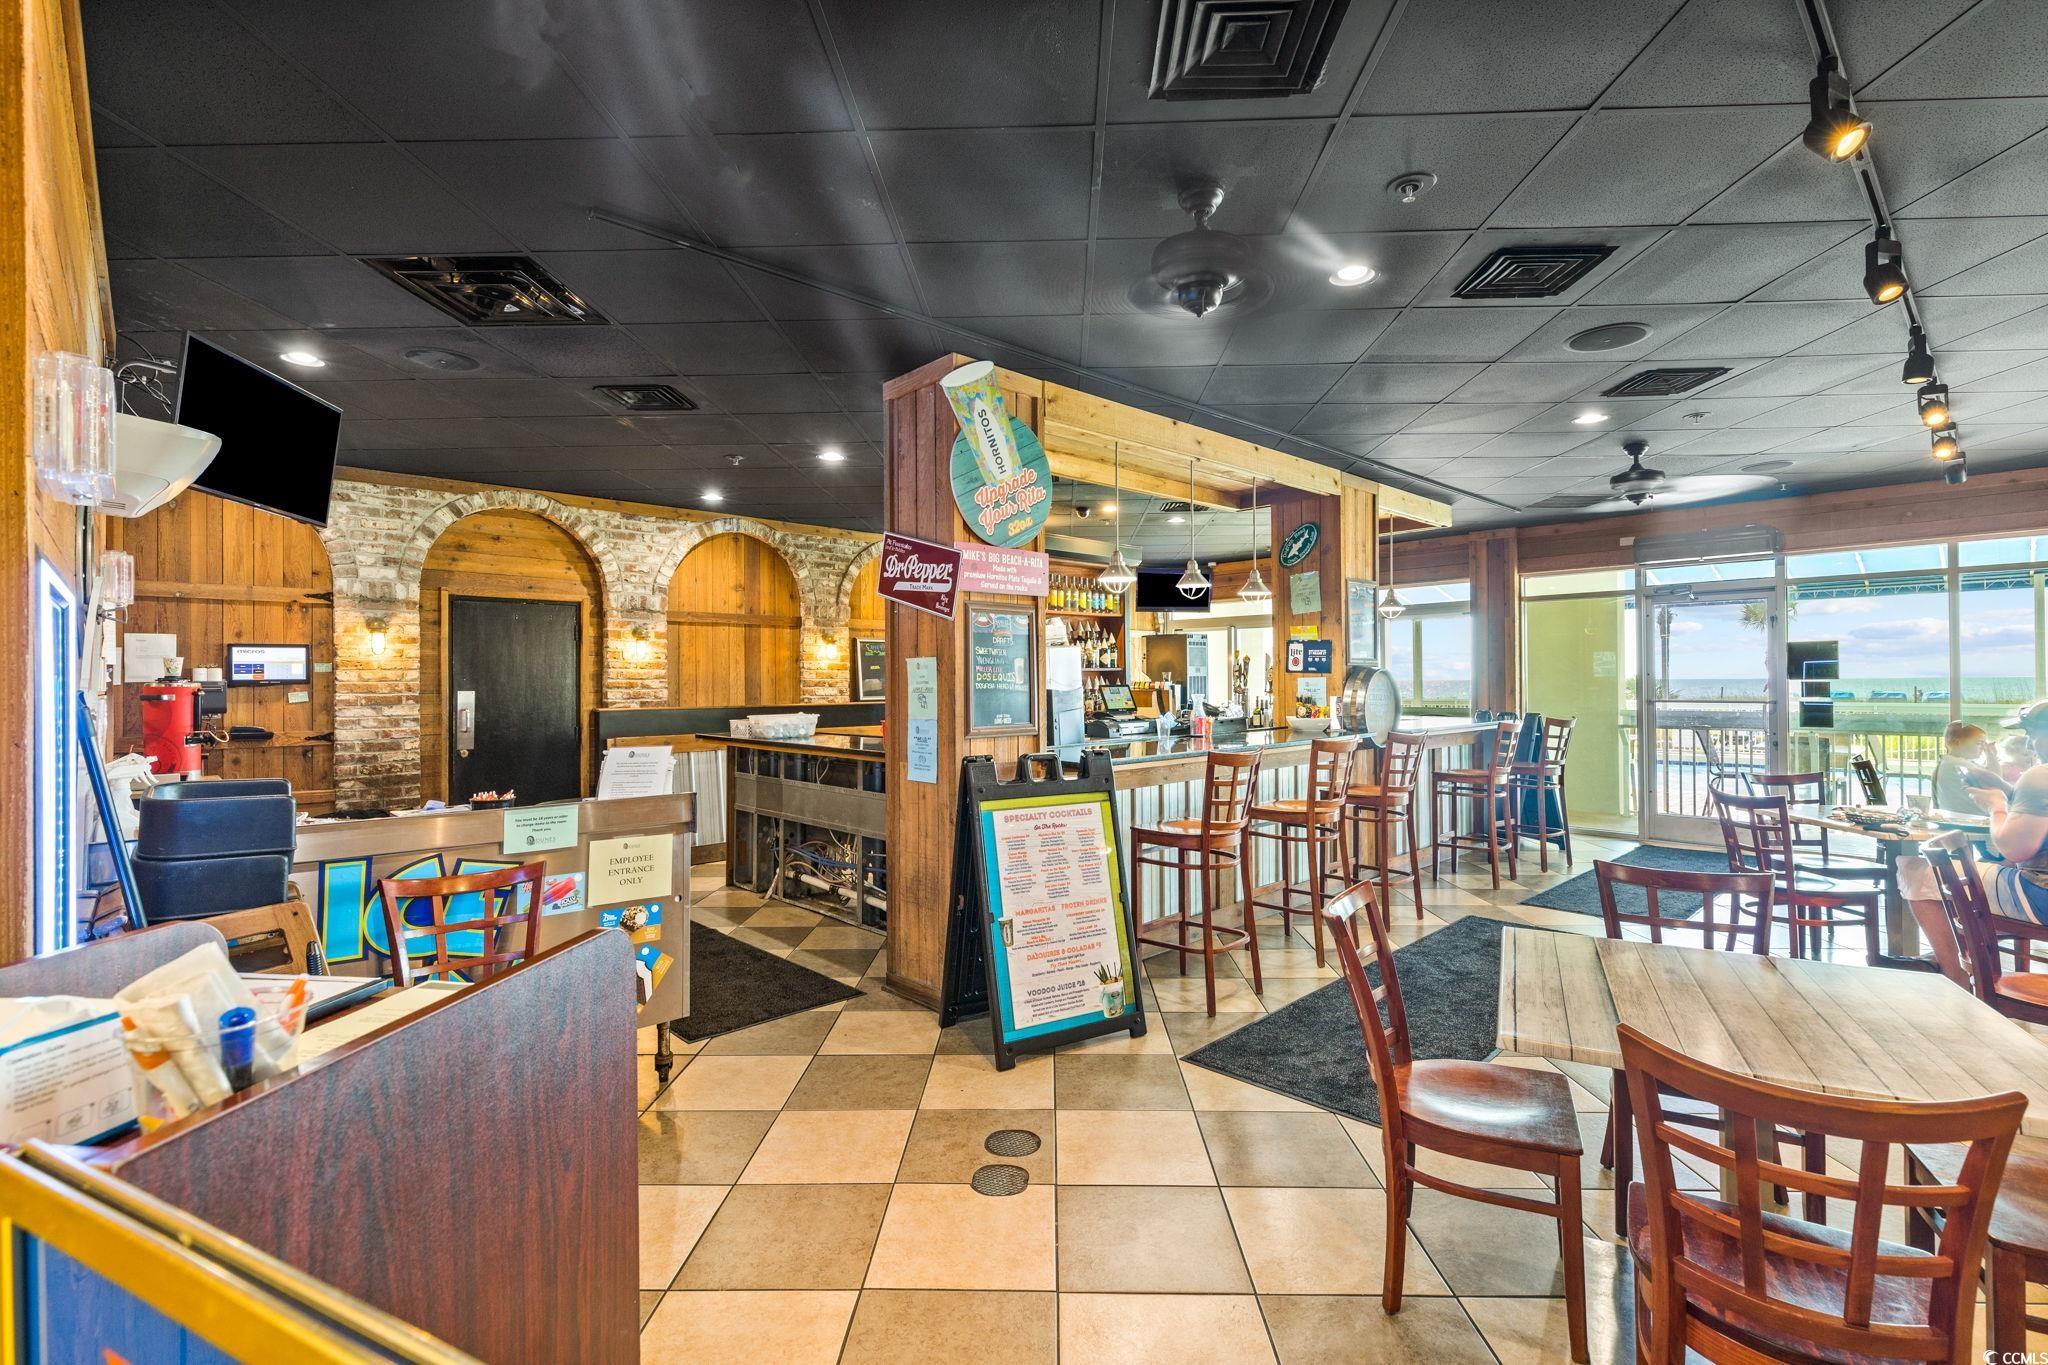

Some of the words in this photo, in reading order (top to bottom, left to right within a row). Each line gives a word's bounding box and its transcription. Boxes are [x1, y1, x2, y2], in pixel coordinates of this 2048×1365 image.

[976, 408, 1007, 475] HORNITOS
[975, 467, 1037, 508] Upgrade
[979, 500, 1018, 535] Your
[1016, 486, 1046, 513] Rita
[962, 549, 986, 562] MIKE'S
[988, 552, 1000, 564] BIG
[992, 564, 1007, 572] Made
[1007, 566, 1017, 574] with
[981, 581, 998, 589] Served
[1290, 648, 1303, 657] Lite
[976, 672, 992, 681] DOS
[1003, 812, 1048, 823] SPECIALTY
[1049, 807, 1093, 819] COCKTAILS
[609, 853, 655, 866] EMPLOYEE
[608, 864, 655, 877] ENTRANCE
[619, 876, 644, 887] ONLY
[1015, 905, 1056, 917] MARGARITAS
[1061, 901, 1085, 910] FROZEN
[1085, 897, 1107, 906] DRINKS
[1067, 943, 1095, 954] COLADAS
[1026, 985, 1056, 997] VOODOO
[1057, 981, 1076, 991] JUICE
